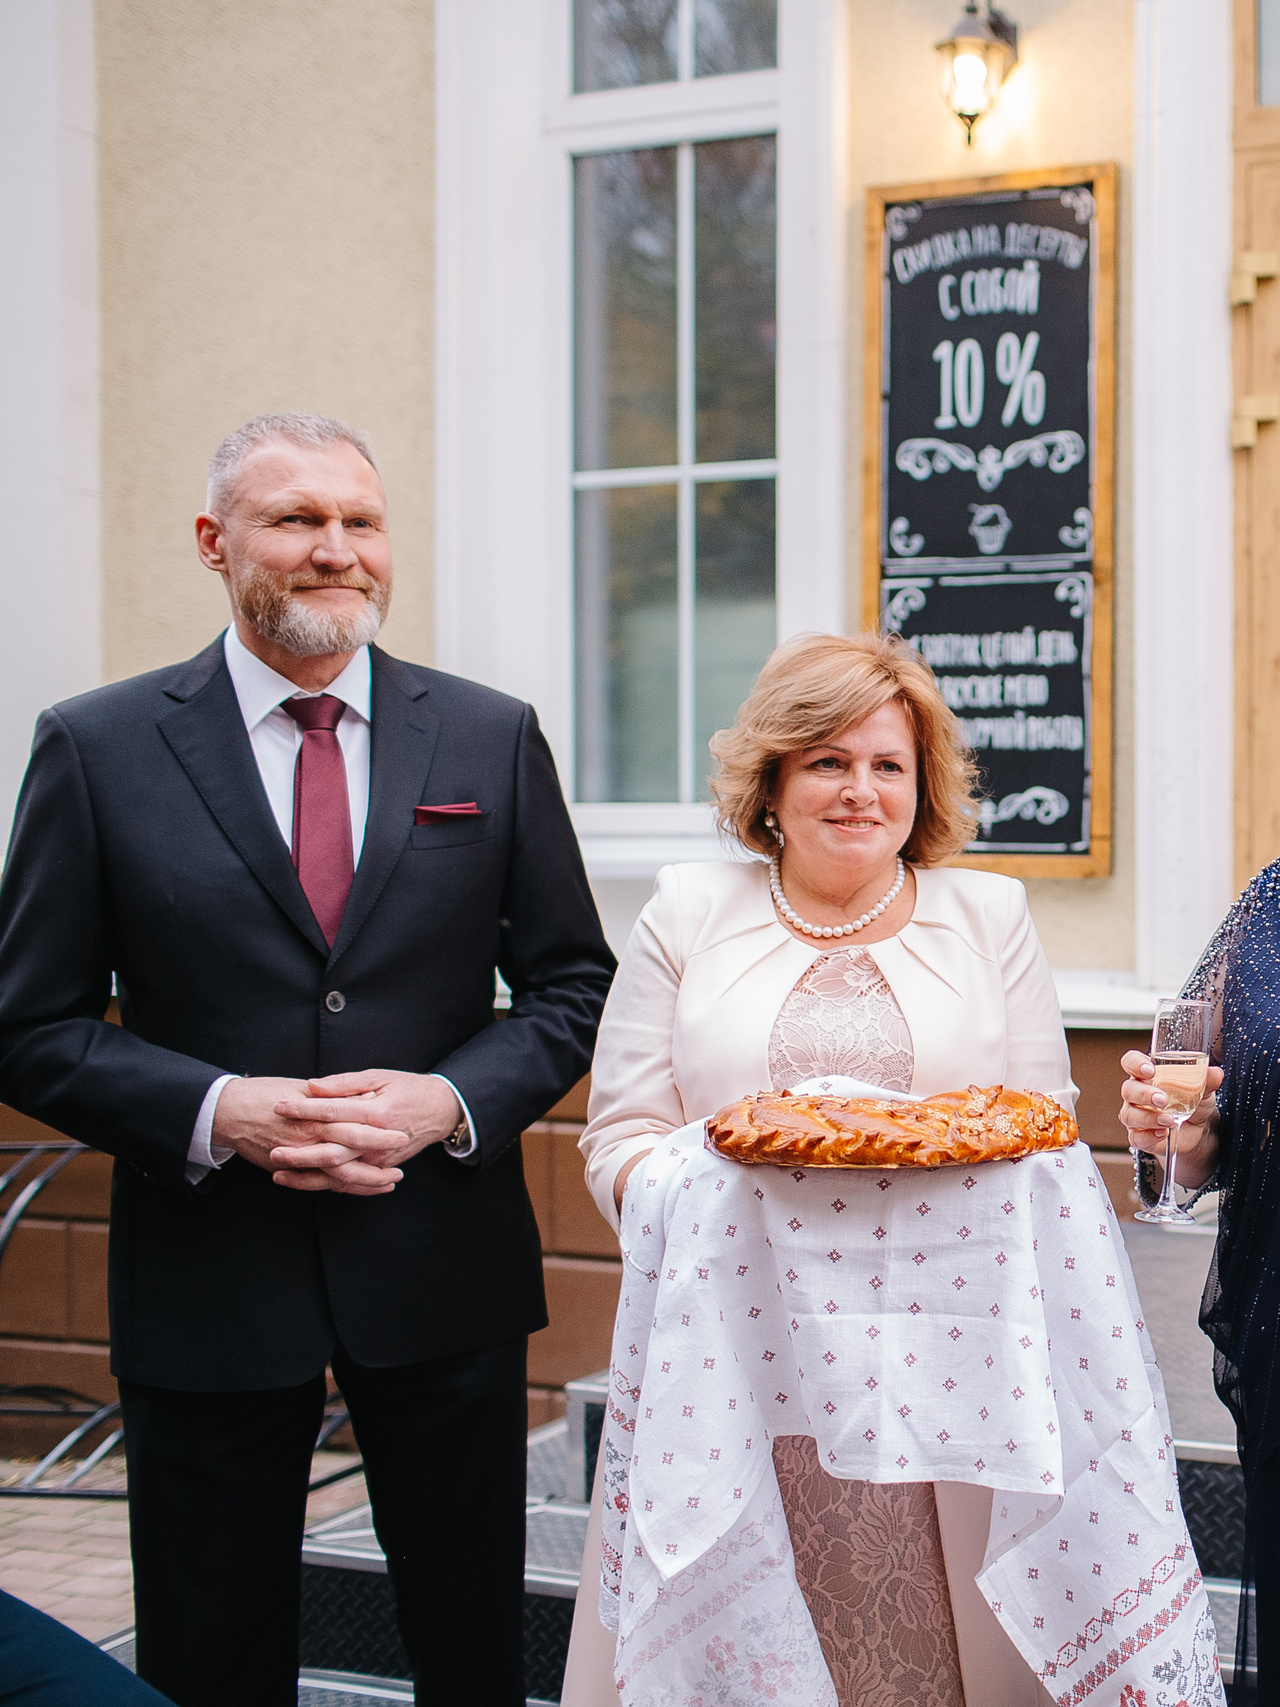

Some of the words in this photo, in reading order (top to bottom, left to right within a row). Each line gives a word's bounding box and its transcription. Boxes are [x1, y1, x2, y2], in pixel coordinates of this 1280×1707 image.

[893, 227, 972, 284] СКИДКА
[970, 223, 1002, 262] НА
[1002, 222, 1088, 270] ДЕСЕРТЫ
[937, 273, 961, 322] С
[960, 259, 1040, 316] СОБОЙ
[932, 338, 985, 430] 10
[995, 331, 1047, 428] %
[1036, 629, 1078, 668] ДЕНЬ
